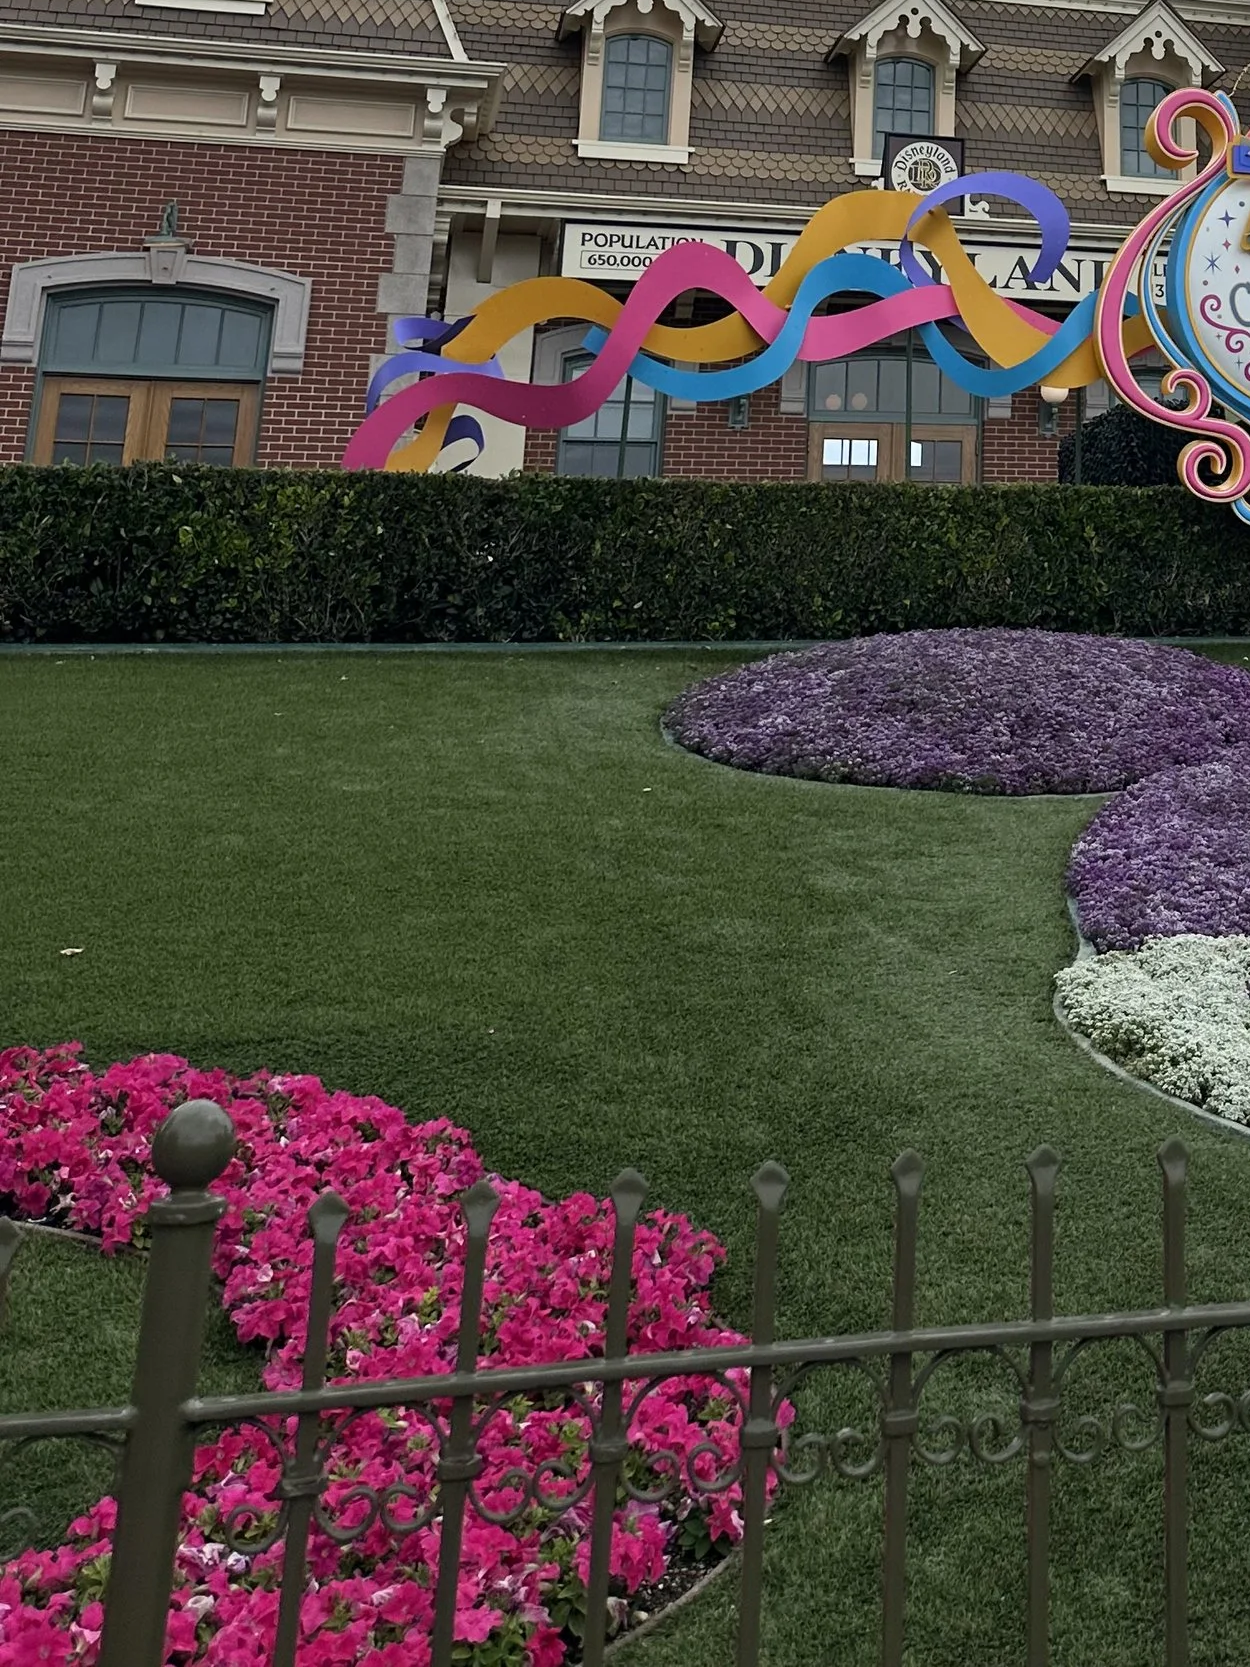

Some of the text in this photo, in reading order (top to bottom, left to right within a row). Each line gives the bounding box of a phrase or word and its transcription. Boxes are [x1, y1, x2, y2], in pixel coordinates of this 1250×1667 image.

[894, 145, 956, 174] Disneyland
[580, 232, 704, 251] POPULATI
[587, 254, 653, 268] 650,000
